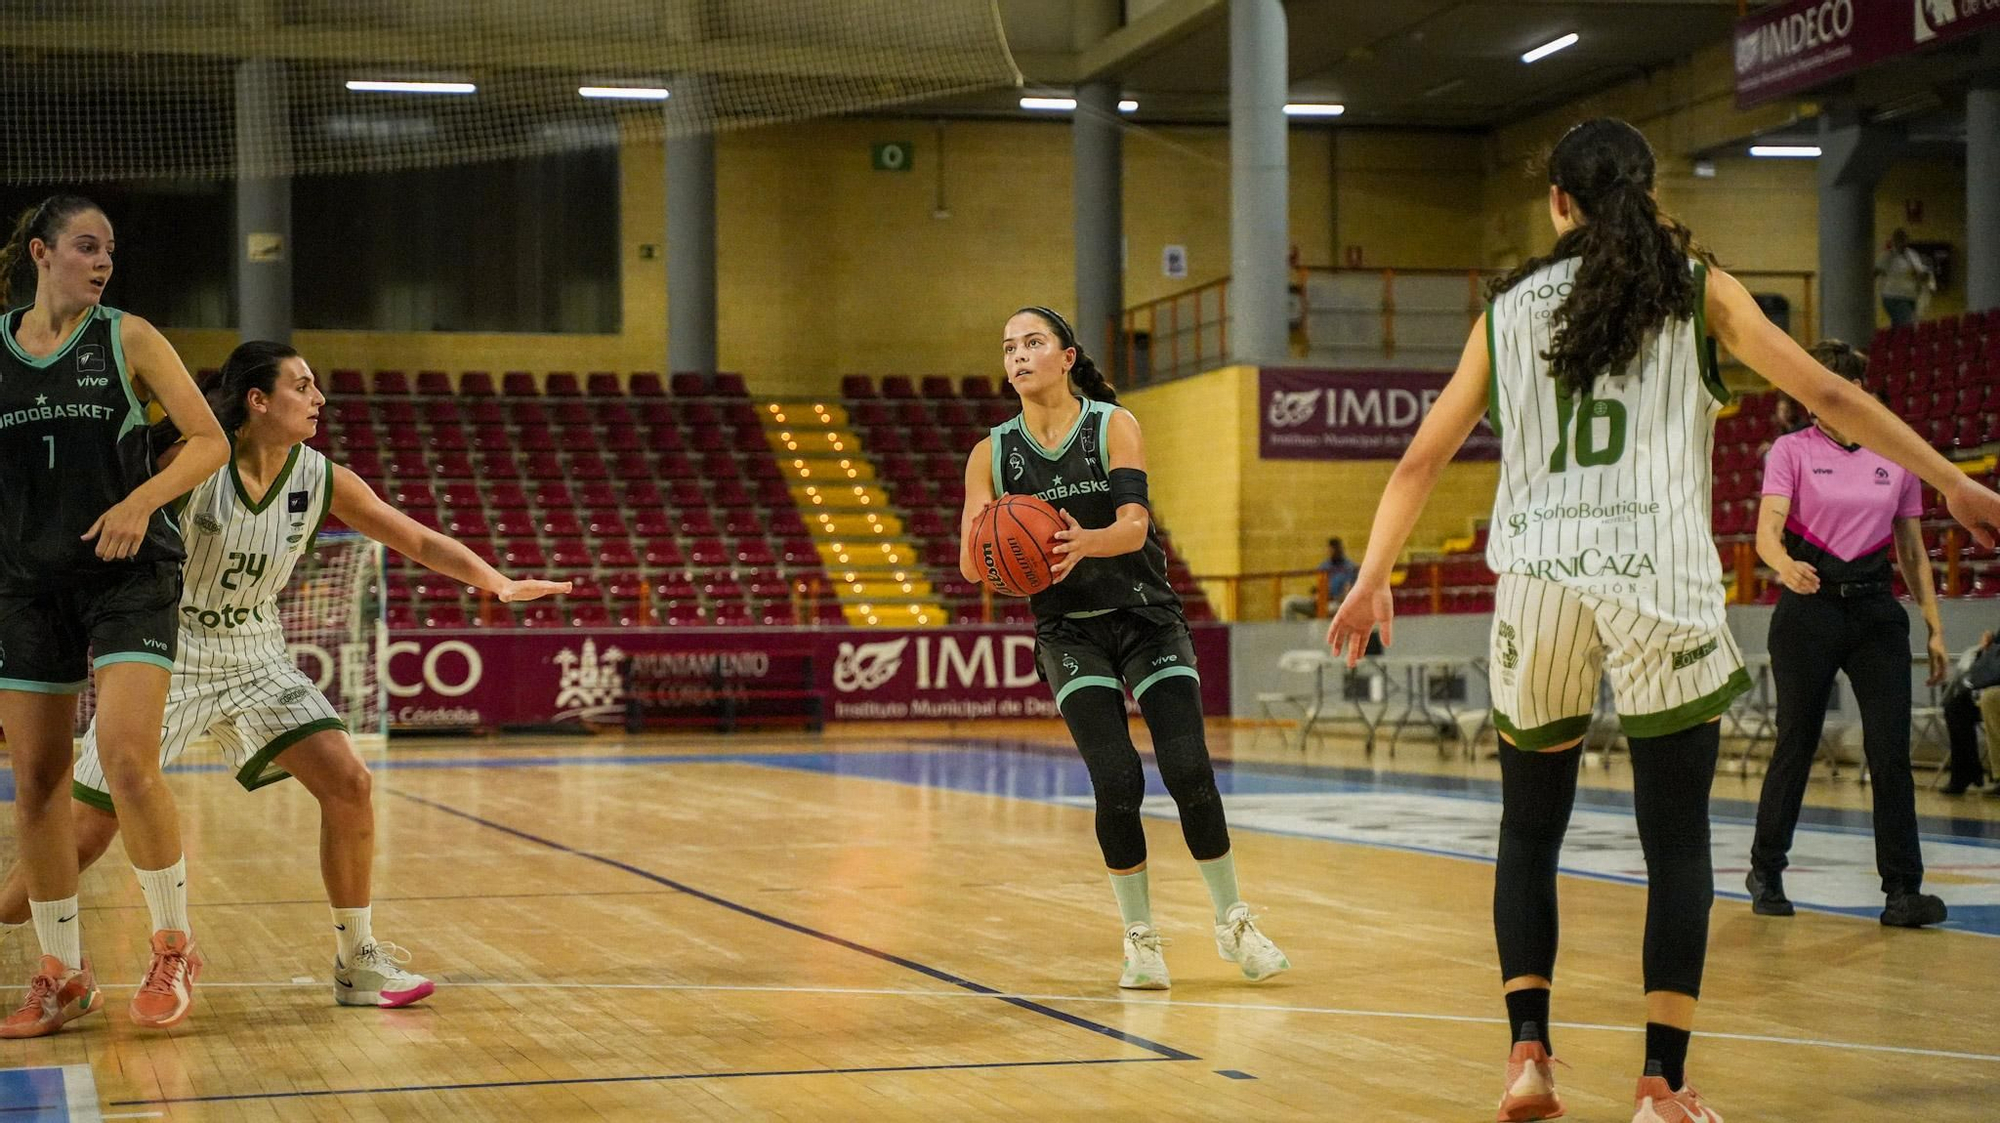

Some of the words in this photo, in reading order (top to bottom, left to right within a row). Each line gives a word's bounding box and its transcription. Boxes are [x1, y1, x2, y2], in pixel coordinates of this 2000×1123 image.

[1761, 0, 1854, 63] IMDECO
[1520, 282, 1575, 307] noo
[77, 375, 109, 387] vive
[0, 404, 115, 429] RDOBASKET
[1325, 387, 1441, 428] IMDE
[1549, 362, 1628, 474] 16
[42, 435, 55, 469] 1
[1032, 480, 1110, 502] DOBASKE
[1533, 501, 1661, 522] SohoBoutique
[220, 552, 268, 591] 24
[143, 638, 168, 651] vive
[284, 640, 484, 698] DECO
[915, 635, 1037, 690] IMD
[1151, 653, 1178, 667] vive
[399, 706, 481, 725] Córdoba
[910, 700, 996, 720] Municipal
[1024, 698, 1058, 719] Dep
